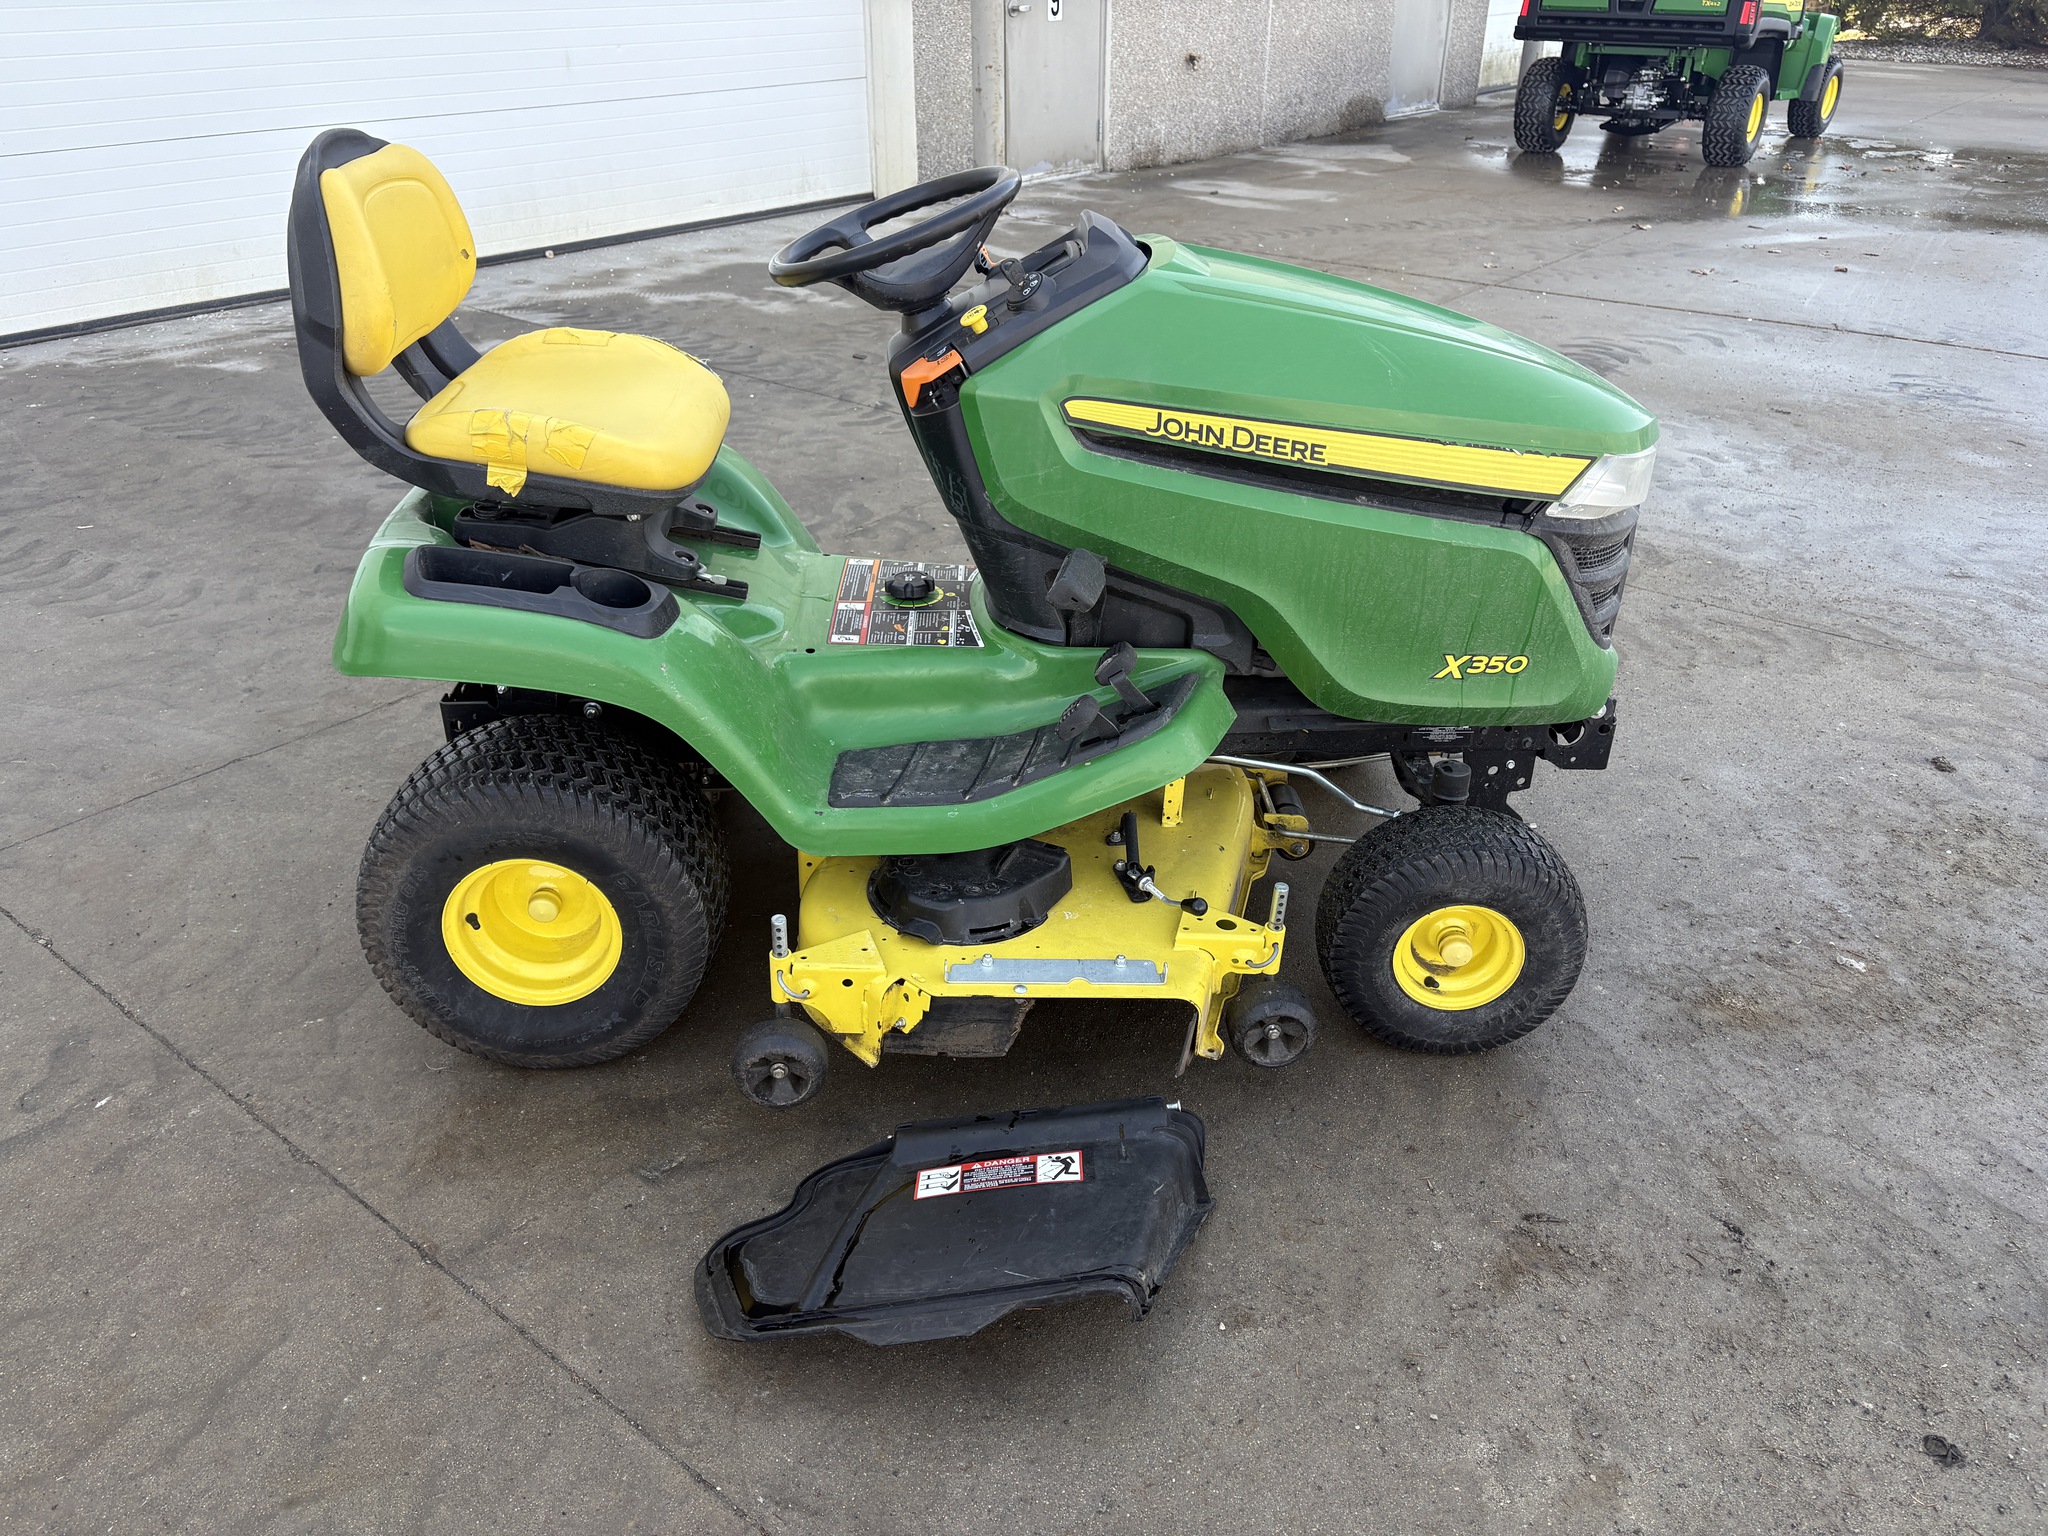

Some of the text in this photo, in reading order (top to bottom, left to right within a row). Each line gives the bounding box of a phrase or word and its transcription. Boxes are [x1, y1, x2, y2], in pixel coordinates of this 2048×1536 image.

[1145, 411, 1327, 464] JOHN DEERE
[1431, 653, 1530, 680] X350
[612, 872, 666, 1009] CARLISLE
[984, 1156, 1030, 1167] DANGER
